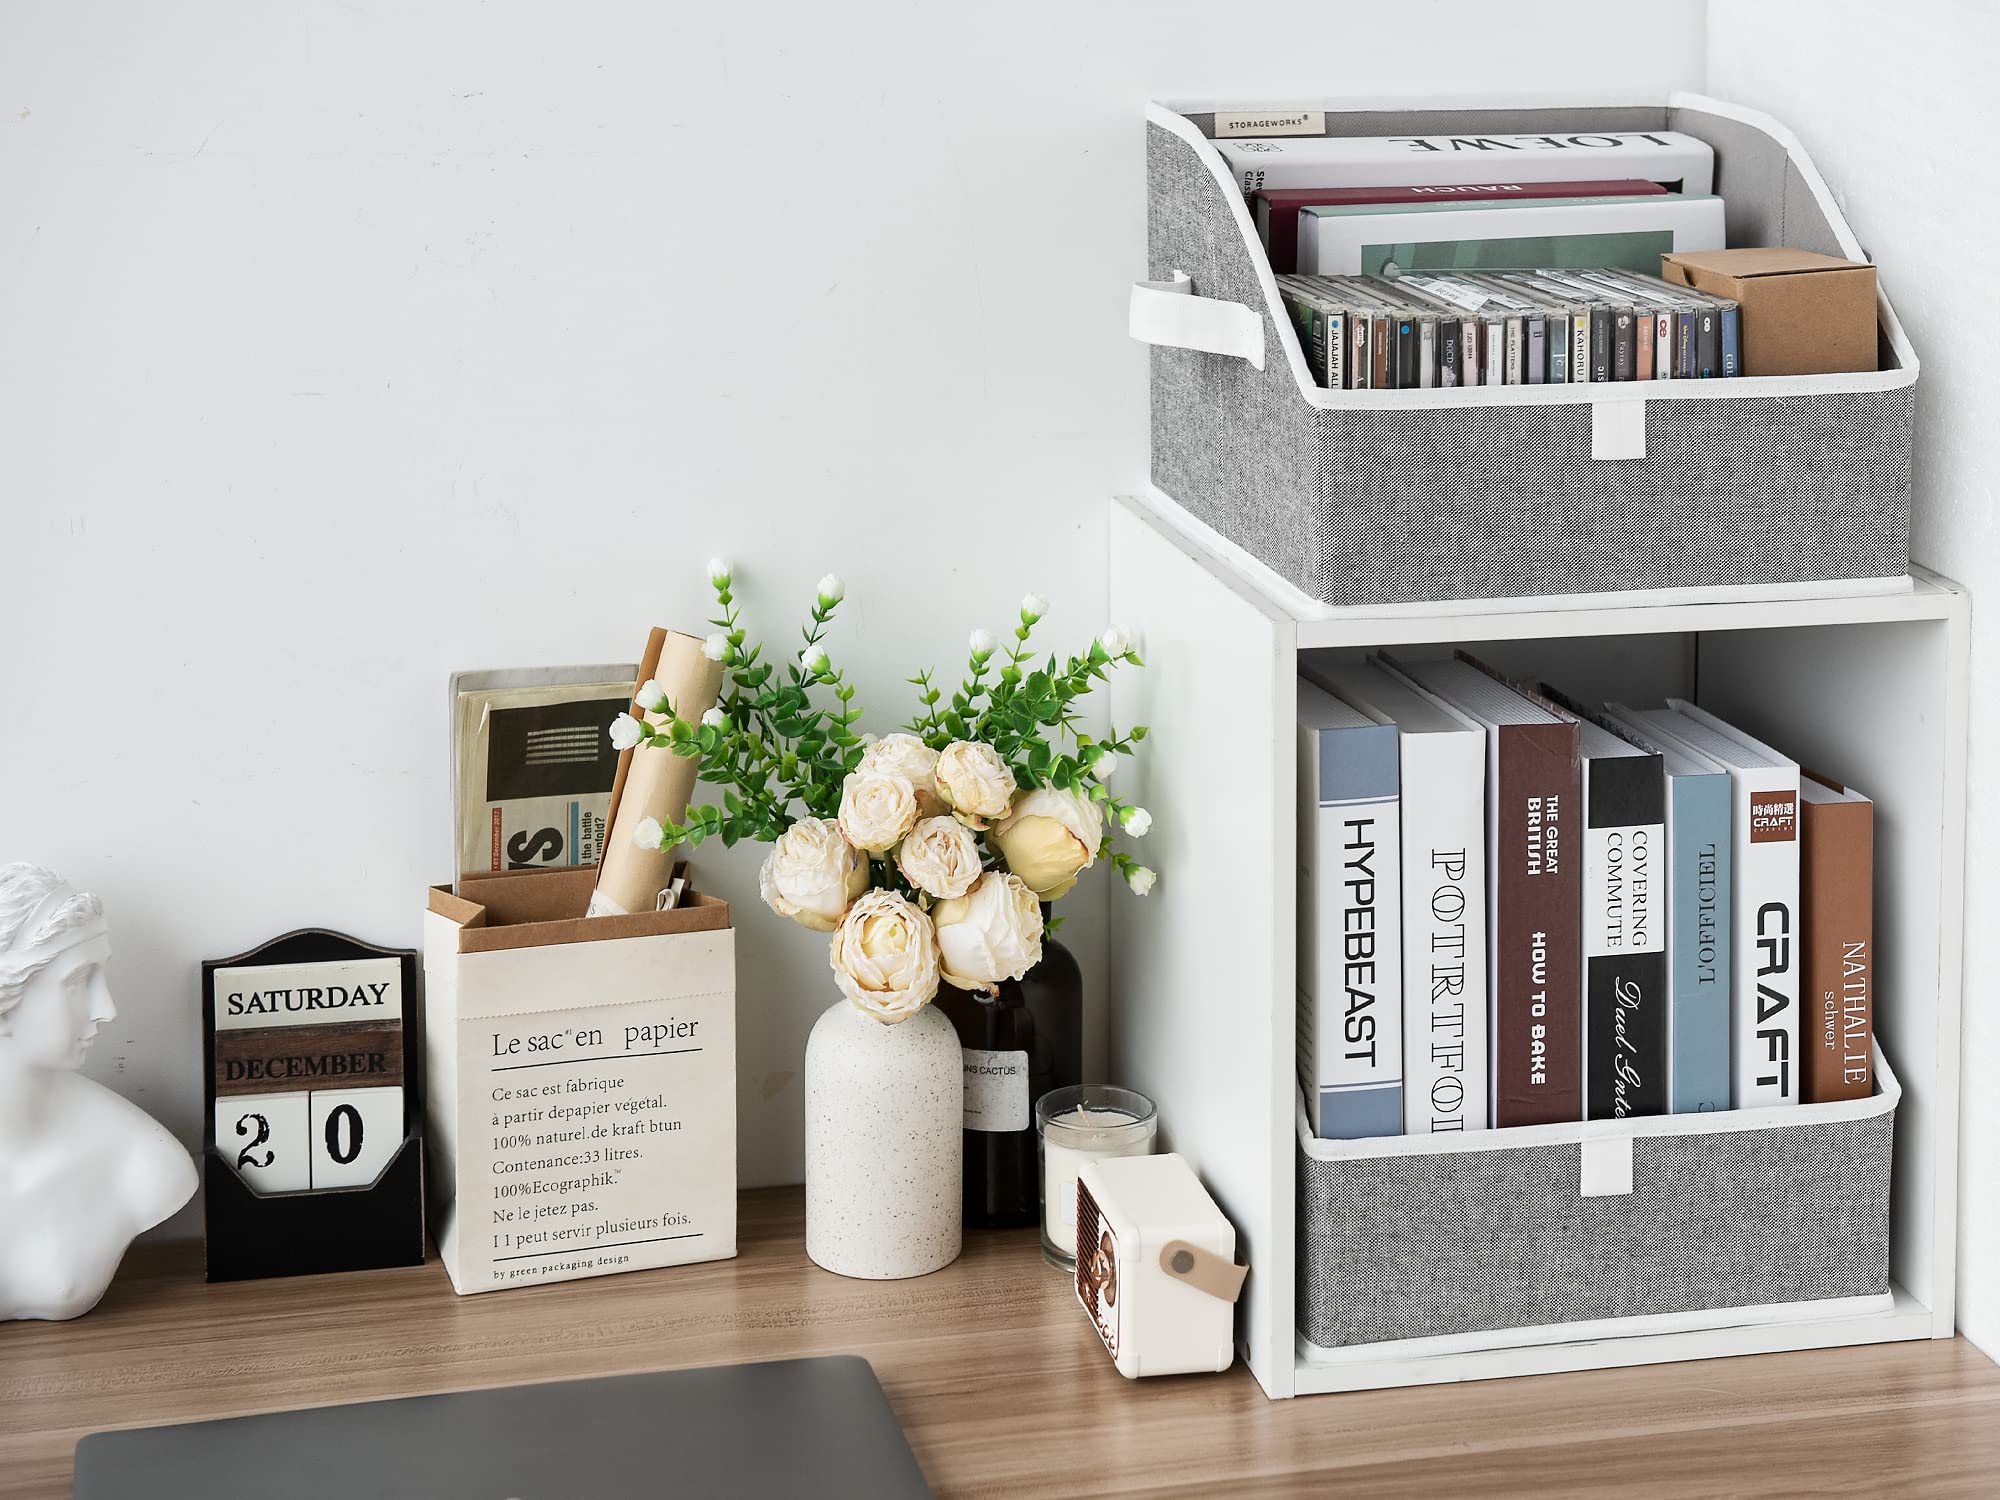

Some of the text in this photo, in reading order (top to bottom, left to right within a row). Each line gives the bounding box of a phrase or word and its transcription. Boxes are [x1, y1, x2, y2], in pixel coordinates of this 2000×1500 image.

[1388, 133, 1672, 152] LOEWE
[1412, 184, 1523, 194] RAUCH
[1331, 329, 1339, 369] JAJAJAH
[1577, 330, 1585, 375] KAHORU
[581, 811, 592, 840] battle
[1752, 802, 1794, 816] 時尚精選
[1753, 816, 1794, 828] CRAFT
[581, 843, 592, 859] the
[1546, 794, 1558, 875] THE GREAT
[1606, 832, 1623, 949] COMMUTE
[1632, 830, 1648, 948] COVERING
[1698, 843, 1716, 985] L'OFFICIEL
[1344, 818, 1376, 1067] HYPEBEAST
[227, 982, 390, 1016] SATURDAY
[1530, 931, 1546, 1085] HOW TO BAKE
[1615, 976, 1641, 1054] Duel
[1756, 902, 1790, 1098] CRAFT
[1842, 940, 1868, 1087] NATHALIE
[492, 1034, 520, 1057] Le
[575, 1028, 603, 1047] en
[624, 1017, 699, 1049] papier
[1824, 991, 1836, 1051] schwer
[225, 1053, 386, 1081] DECEMBER
[979, 1066, 1016, 1075] CACTUS
[492, 1077, 624, 1101] Ce sac est fabrique
[492, 1112, 499, 1126] à
[504, 1108, 544, 1128] partir
[493, 1134, 531, 1150] 100%
[612, 1120, 645, 1137] kraft
[649, 1119, 682, 1133] btun
[604, 1147, 643, 1162] litres.
[493, 1202, 599, 1224] Ne le jetez pas.
[516, 1231, 548, 1249] peut
[552, 1225, 591, 1241] servir
[596, 1218, 658, 1239] plusieurs
[663, 1212, 691, 1225] fois.
[493, 1254, 629, 1280] by green packaging design
